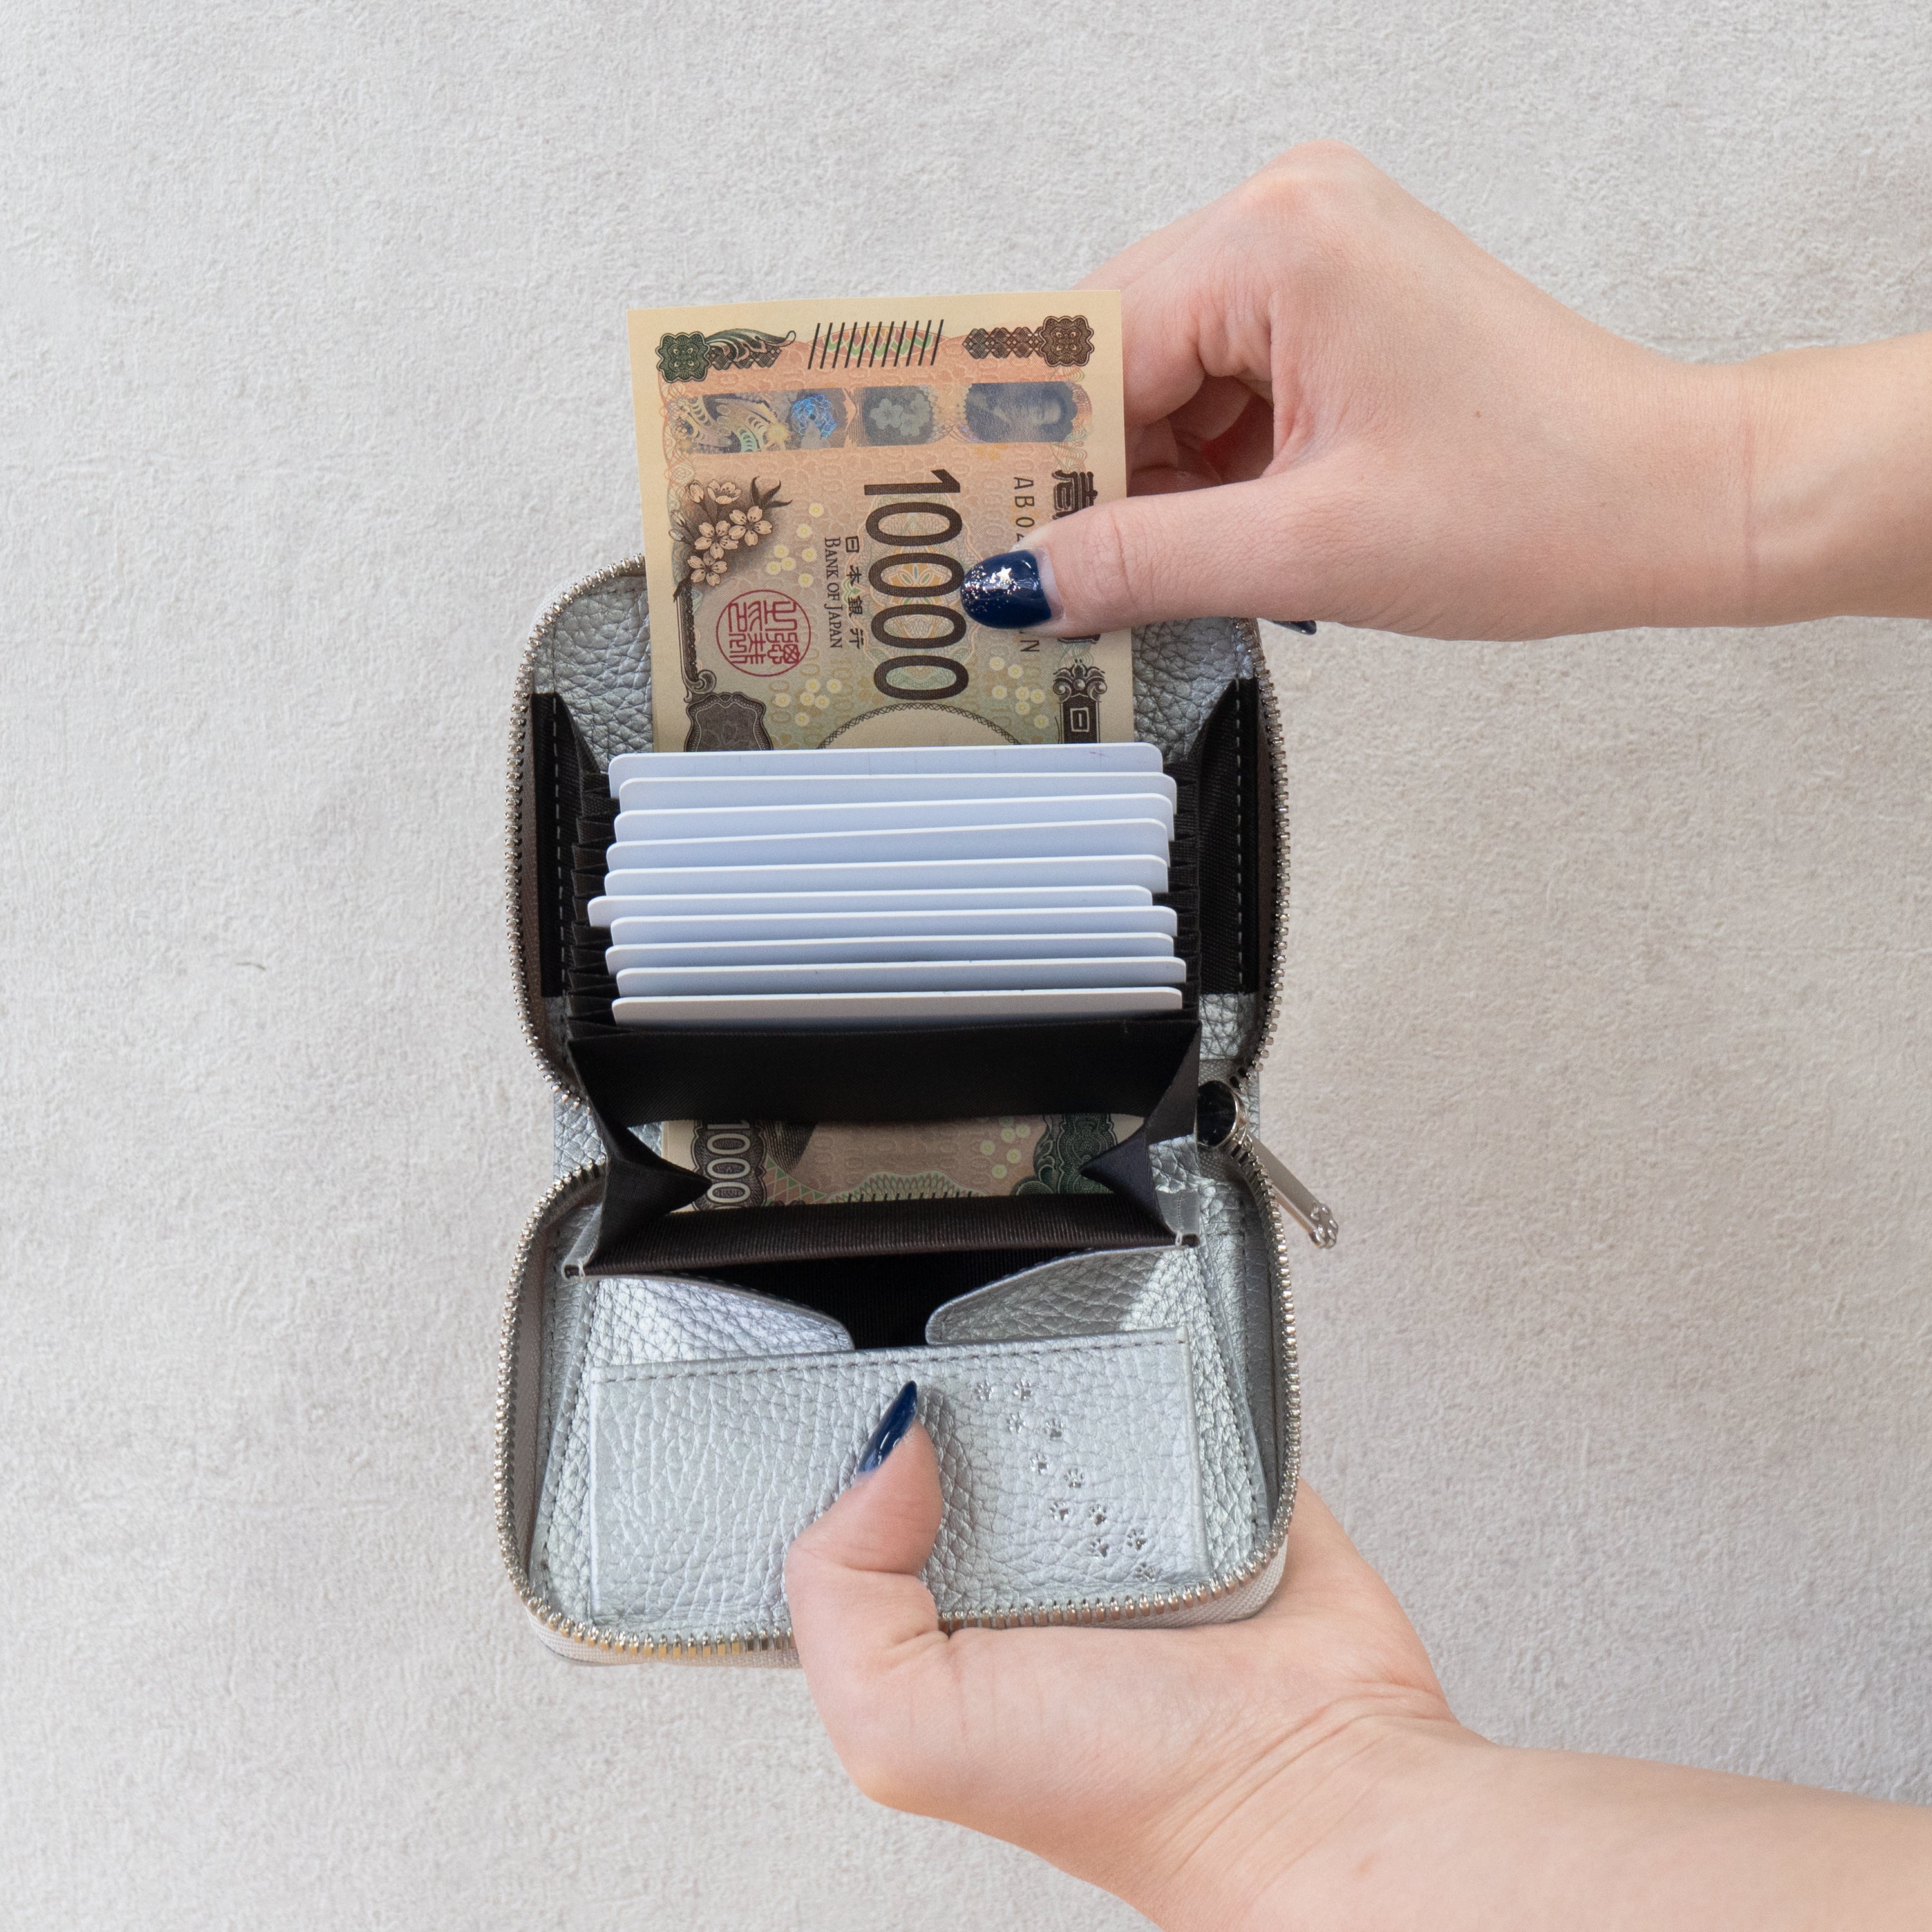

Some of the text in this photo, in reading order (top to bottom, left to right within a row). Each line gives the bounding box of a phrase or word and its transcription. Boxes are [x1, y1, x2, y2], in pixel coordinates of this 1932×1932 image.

[824, 536, 843, 649] BANK OF JAPAN
[846, 536, 864, 649] 日本銀行
[864, 469, 969, 700] 10000
[707, 1123, 751, 1209] 1000
